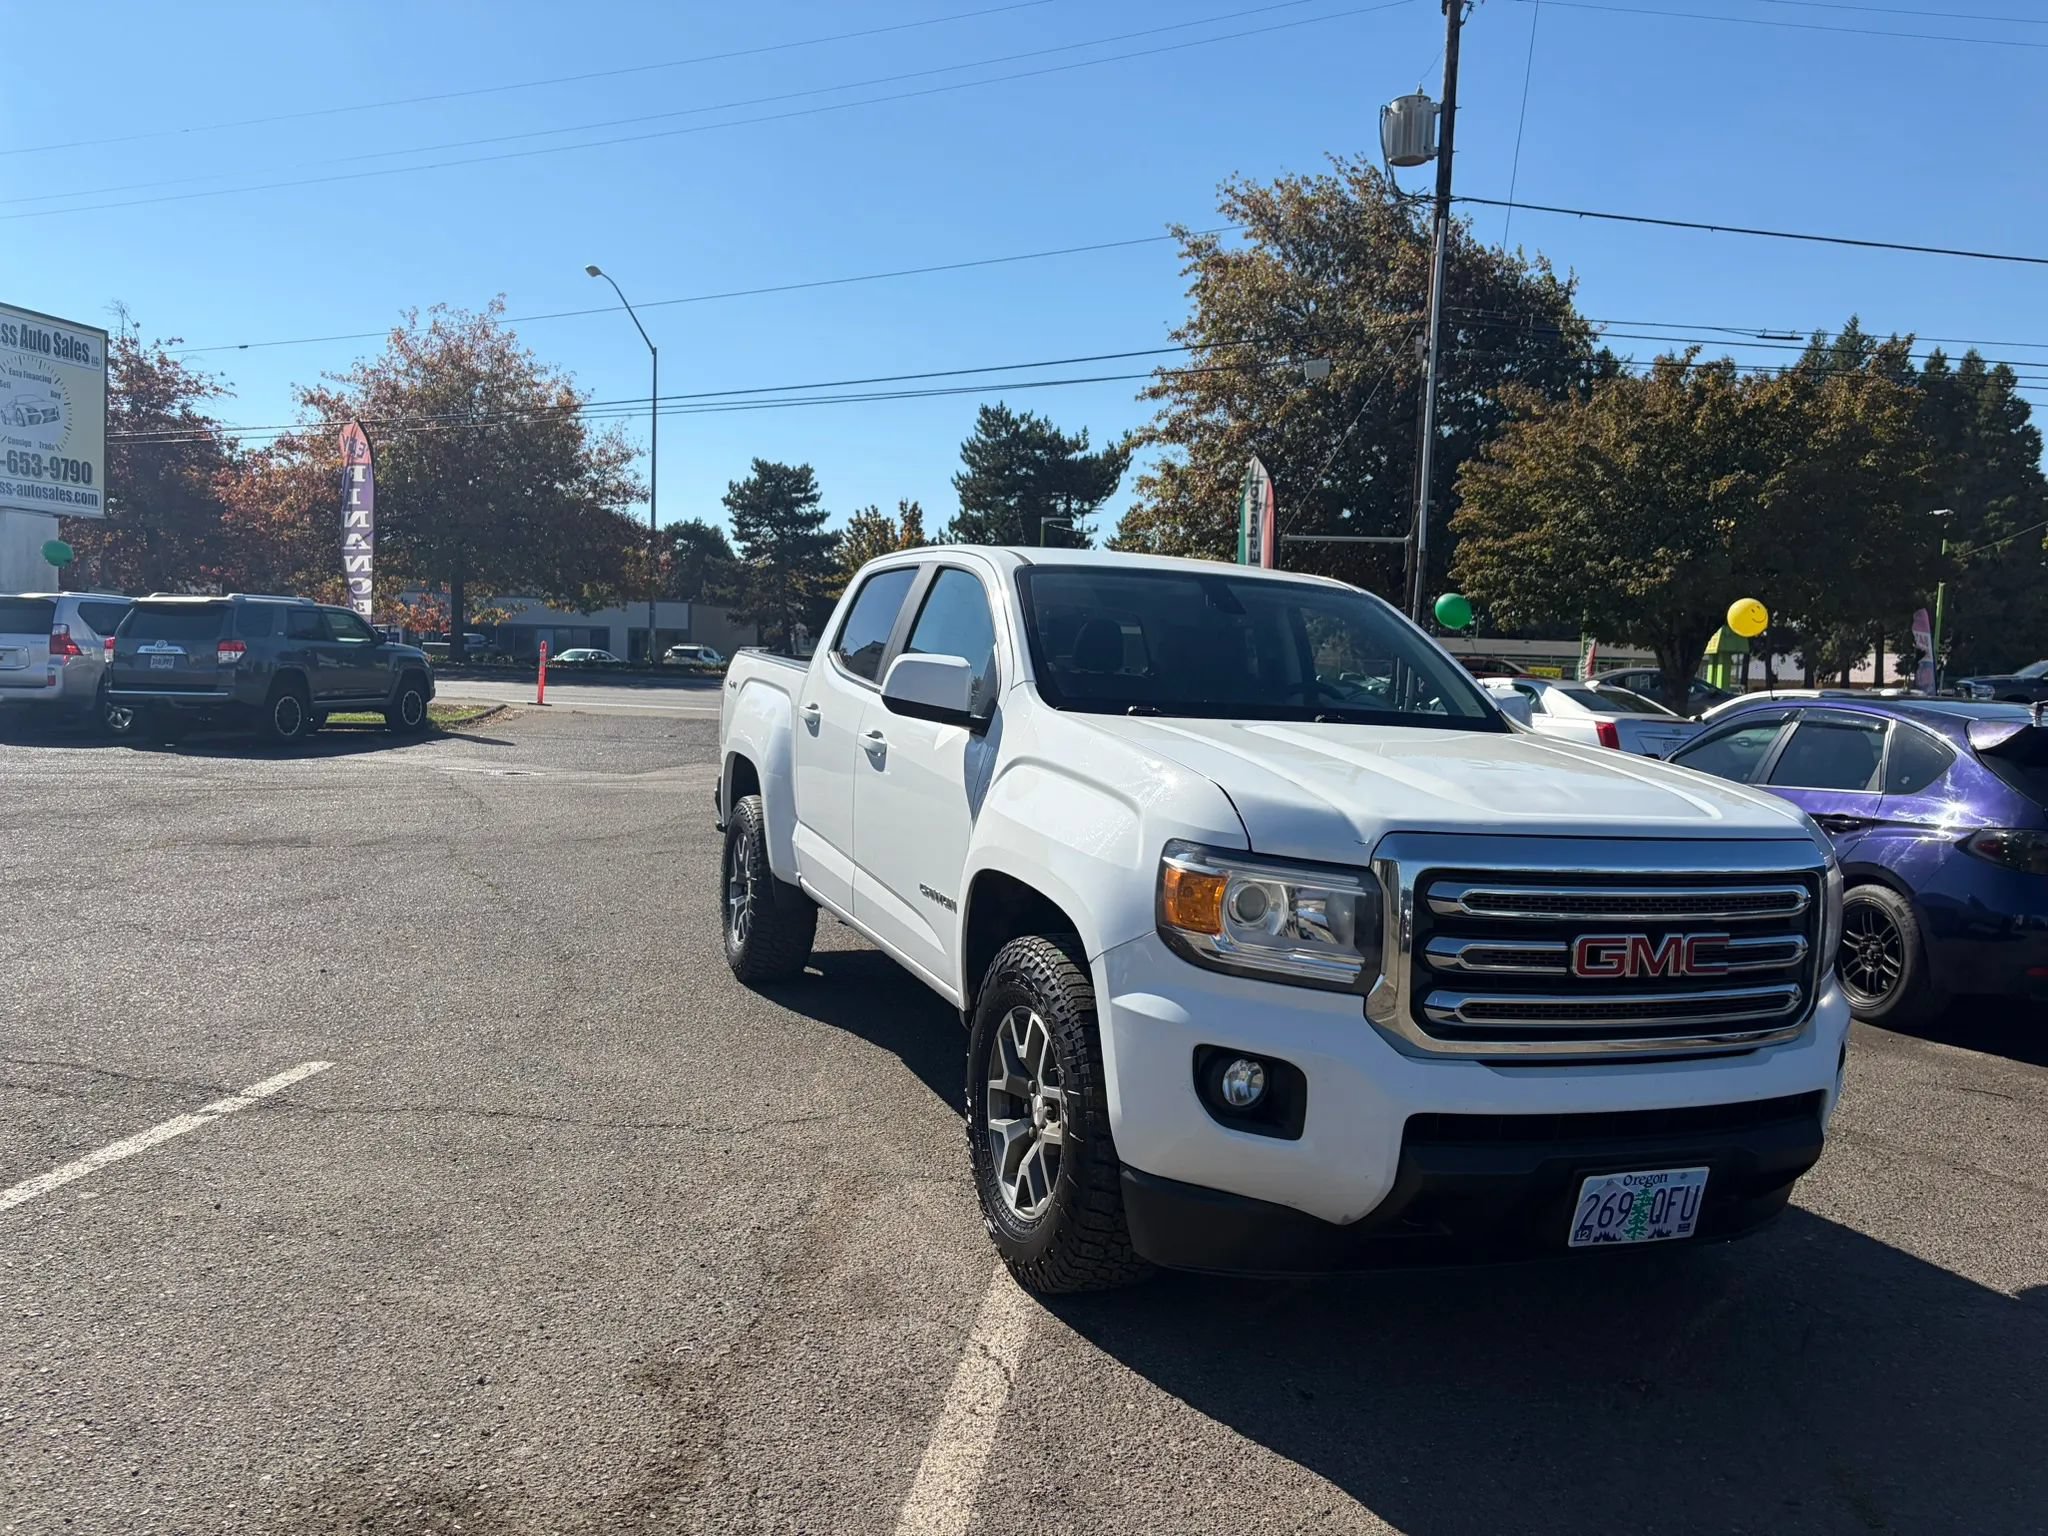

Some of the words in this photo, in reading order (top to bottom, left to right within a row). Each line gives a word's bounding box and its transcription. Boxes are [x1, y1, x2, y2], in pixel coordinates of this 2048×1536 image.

[0, 323, 17, 347] ss
[20, 323, 51, 356] Auto
[53, 331, 90, 365] Sales
[1573, 933, 1730, 978] GMC
[1623, 1173, 1668, 1188] Oregon
[1578, 1191, 1635, 1228] 269
[1649, 1185, 1700, 1224] QFU
